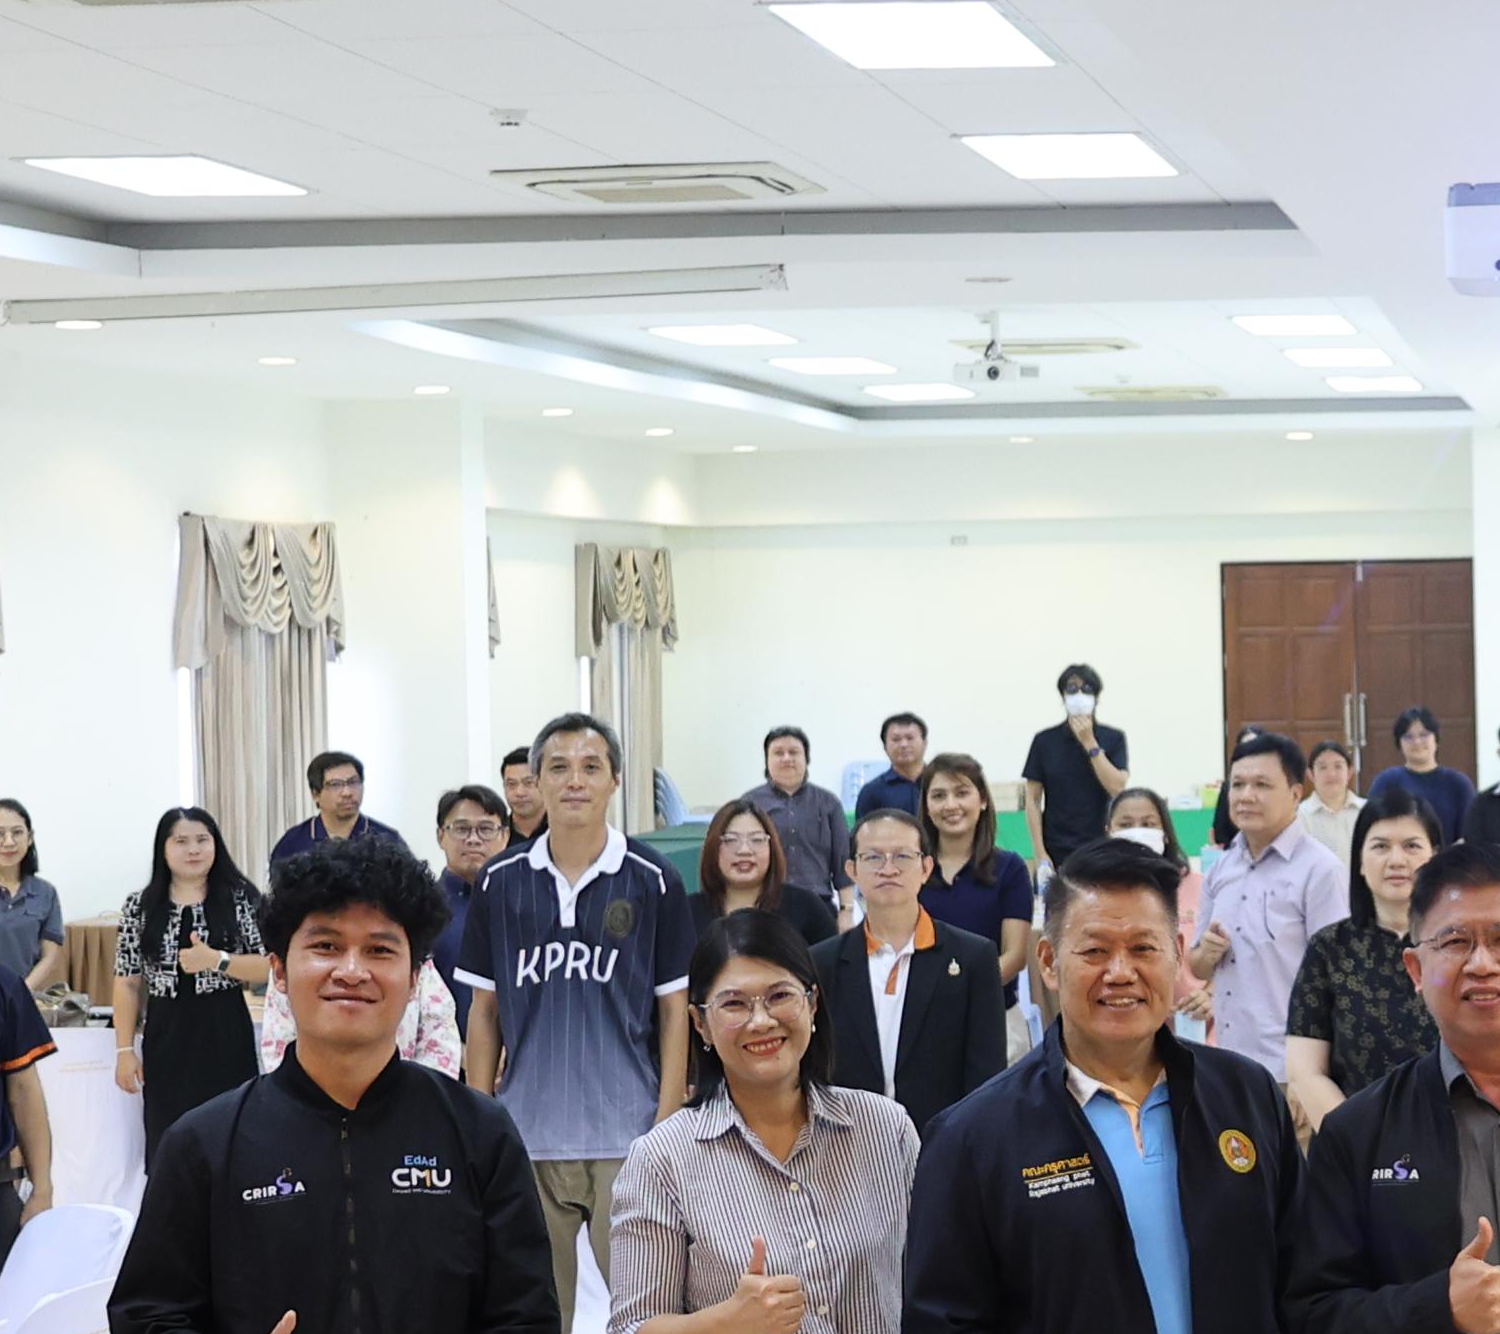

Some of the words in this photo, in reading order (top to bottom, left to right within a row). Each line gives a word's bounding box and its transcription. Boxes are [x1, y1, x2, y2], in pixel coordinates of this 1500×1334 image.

[516, 940, 619, 988] KPRU
[404, 1154, 437, 1167] EdAd
[1371, 1160, 1420, 1180] RIRSA
[242, 1175, 306, 1201] CRIRSA
[391, 1167, 452, 1188] CMU
